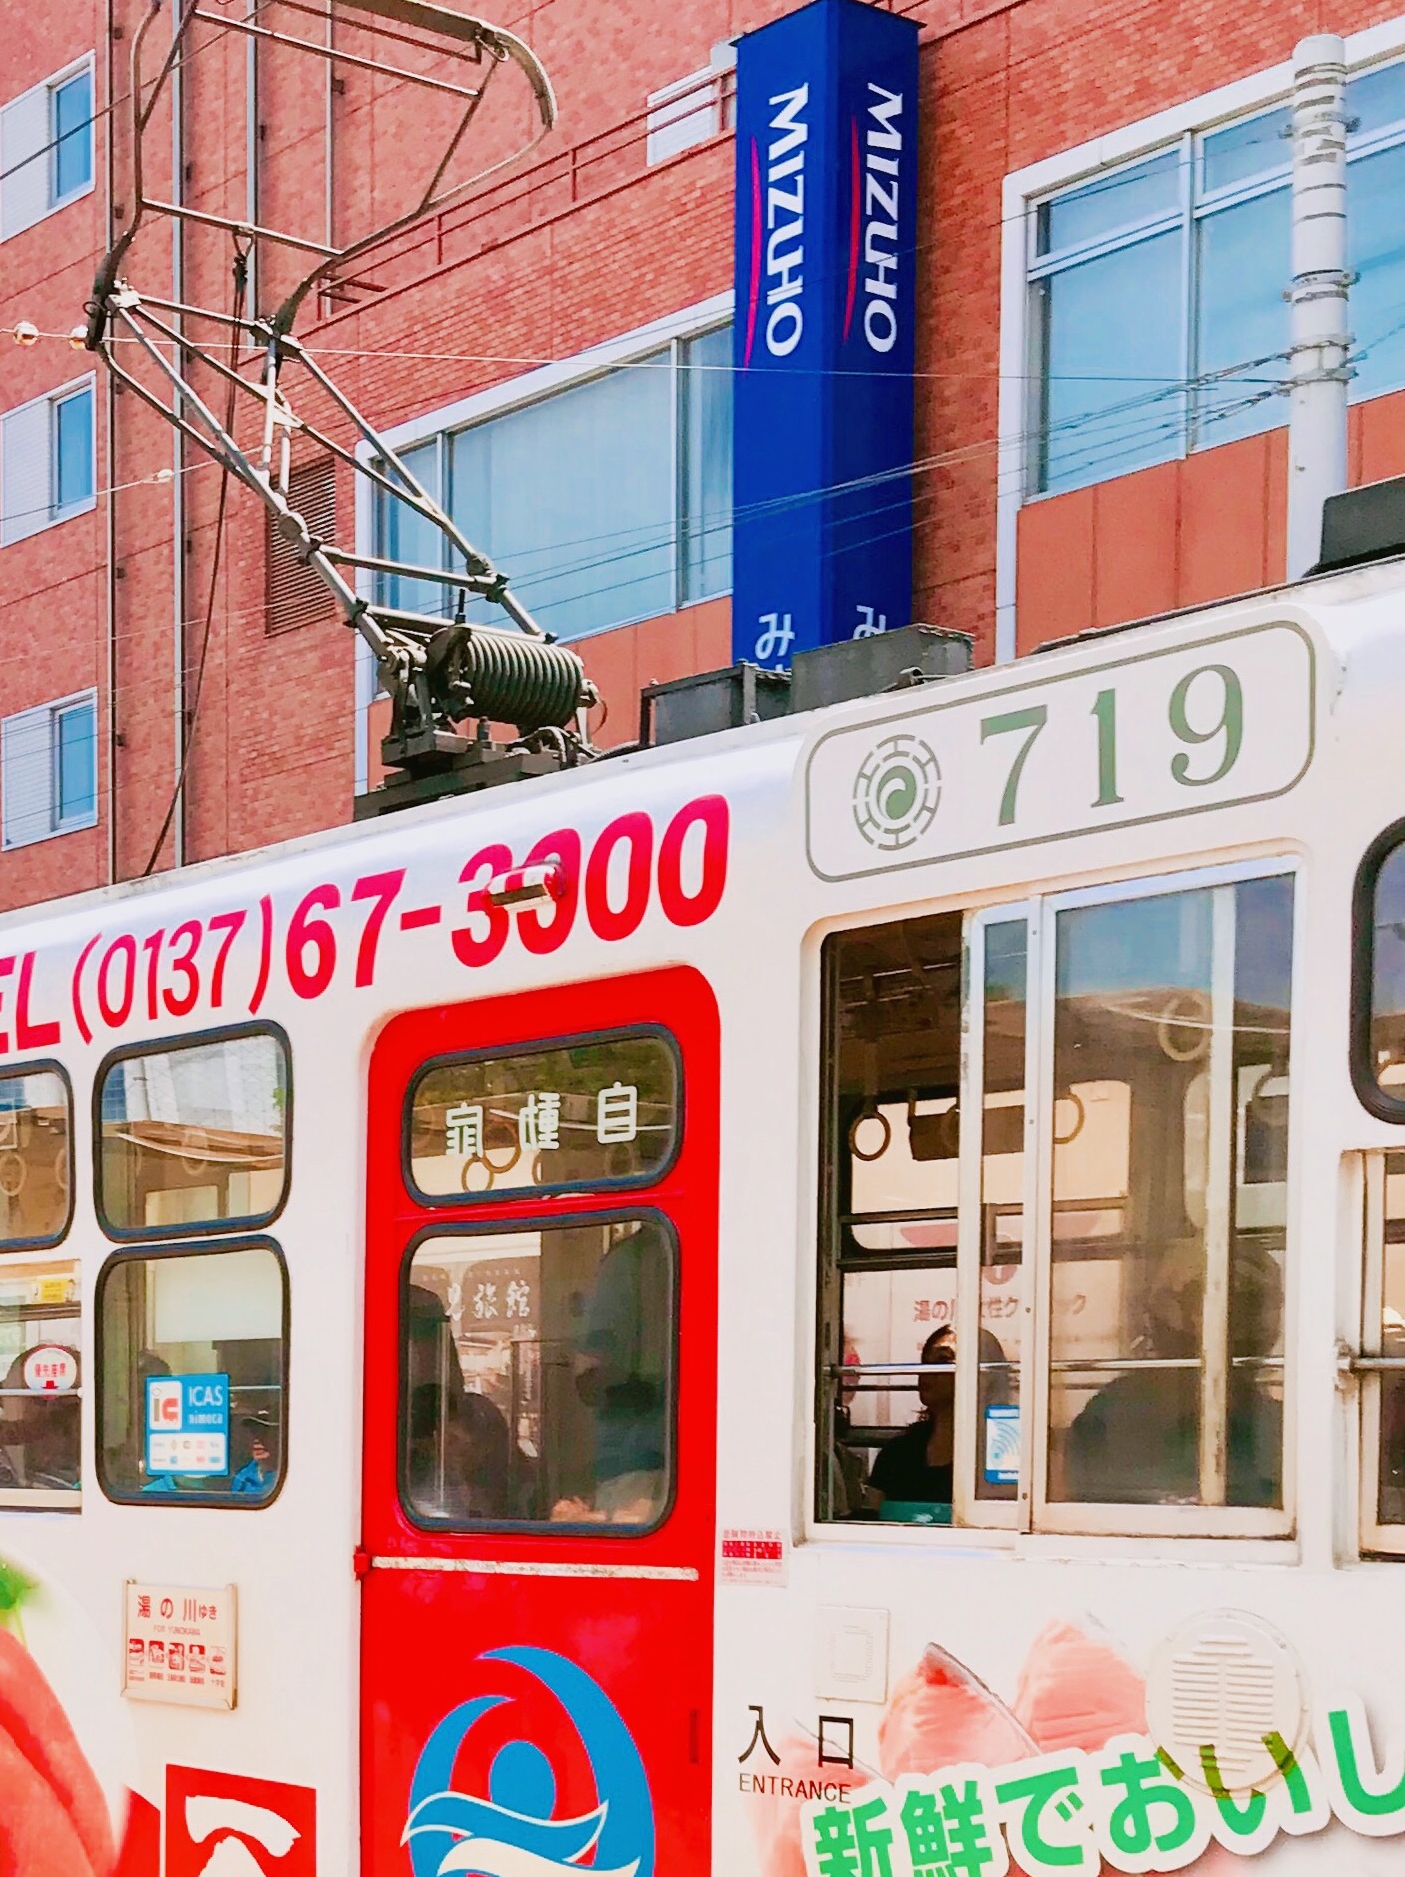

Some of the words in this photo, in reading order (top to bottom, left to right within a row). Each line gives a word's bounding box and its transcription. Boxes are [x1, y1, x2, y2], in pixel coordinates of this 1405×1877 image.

[765, 82, 809, 358] MIZUHO
[863, 82, 905, 354] MIZUHO
[755, 612, 796, 672] み
[979, 663, 1244, 827] 719
[188, 1385, 223, 1407] ICAS
[737, 1705, 856, 1771] 入口
[738, 1772, 852, 1805] ENTRANCE
